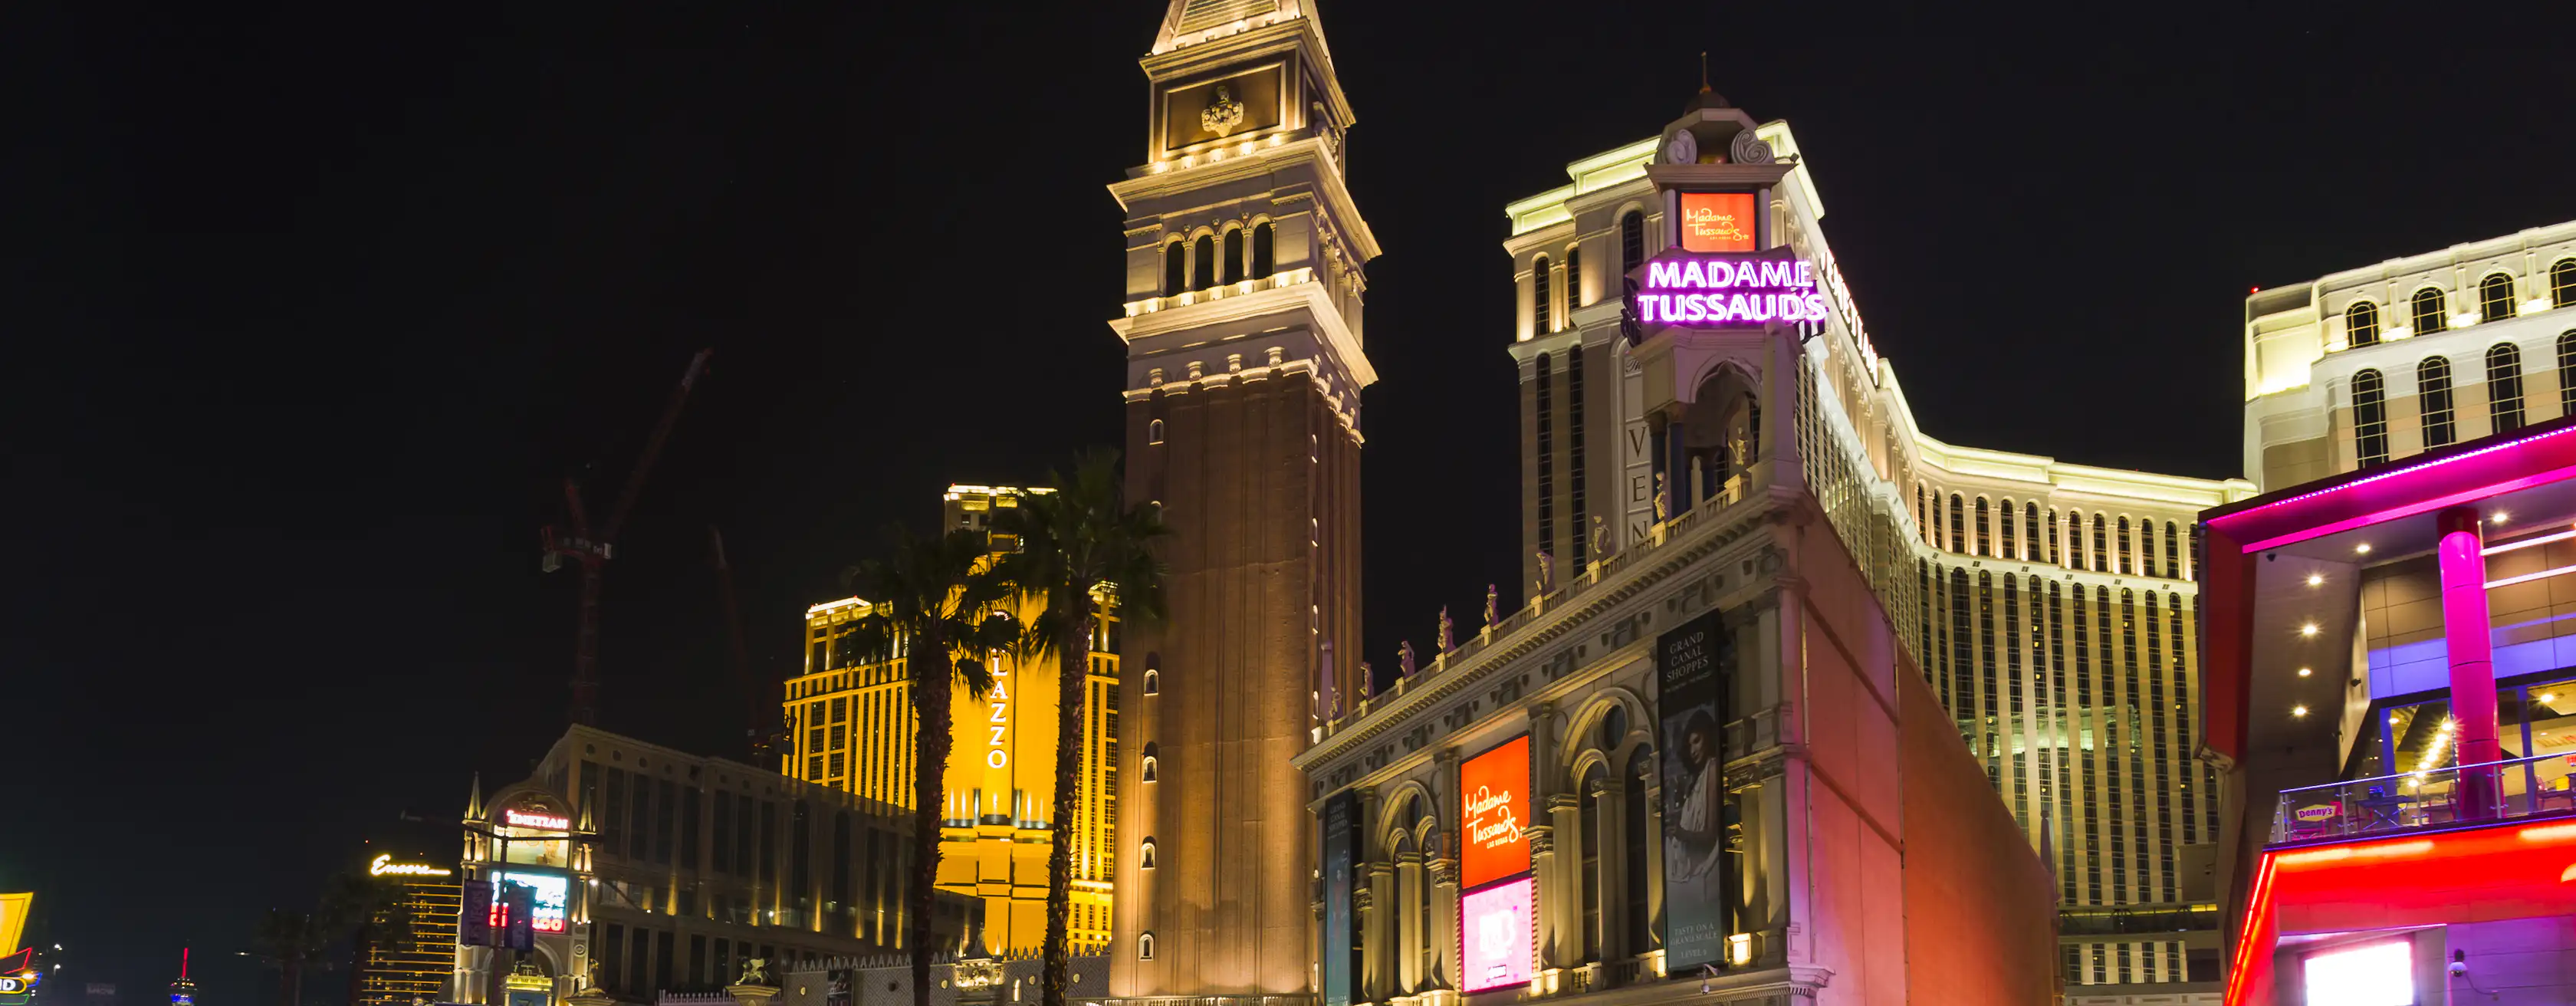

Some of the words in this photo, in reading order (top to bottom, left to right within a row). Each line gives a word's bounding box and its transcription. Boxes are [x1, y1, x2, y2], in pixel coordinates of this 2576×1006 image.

[1687, 208, 1735, 222] Madame
[1687, 221, 1743, 241] Tussauds
[1648, 261, 1814, 288] MADAME
[1638, 291, 1827, 321] TUSSAUD'S
[1670, 632, 1704, 654] GRAND
[1671, 646, 1703, 666] CANAL
[1666, 656, 1708, 682] SHOPPES
[1465, 785, 1511, 819] Madame
[2298, 807, 2332, 818] Denny's
[1467, 805, 1519, 844] Tussauds
[370, 853, 452, 876] Encore
